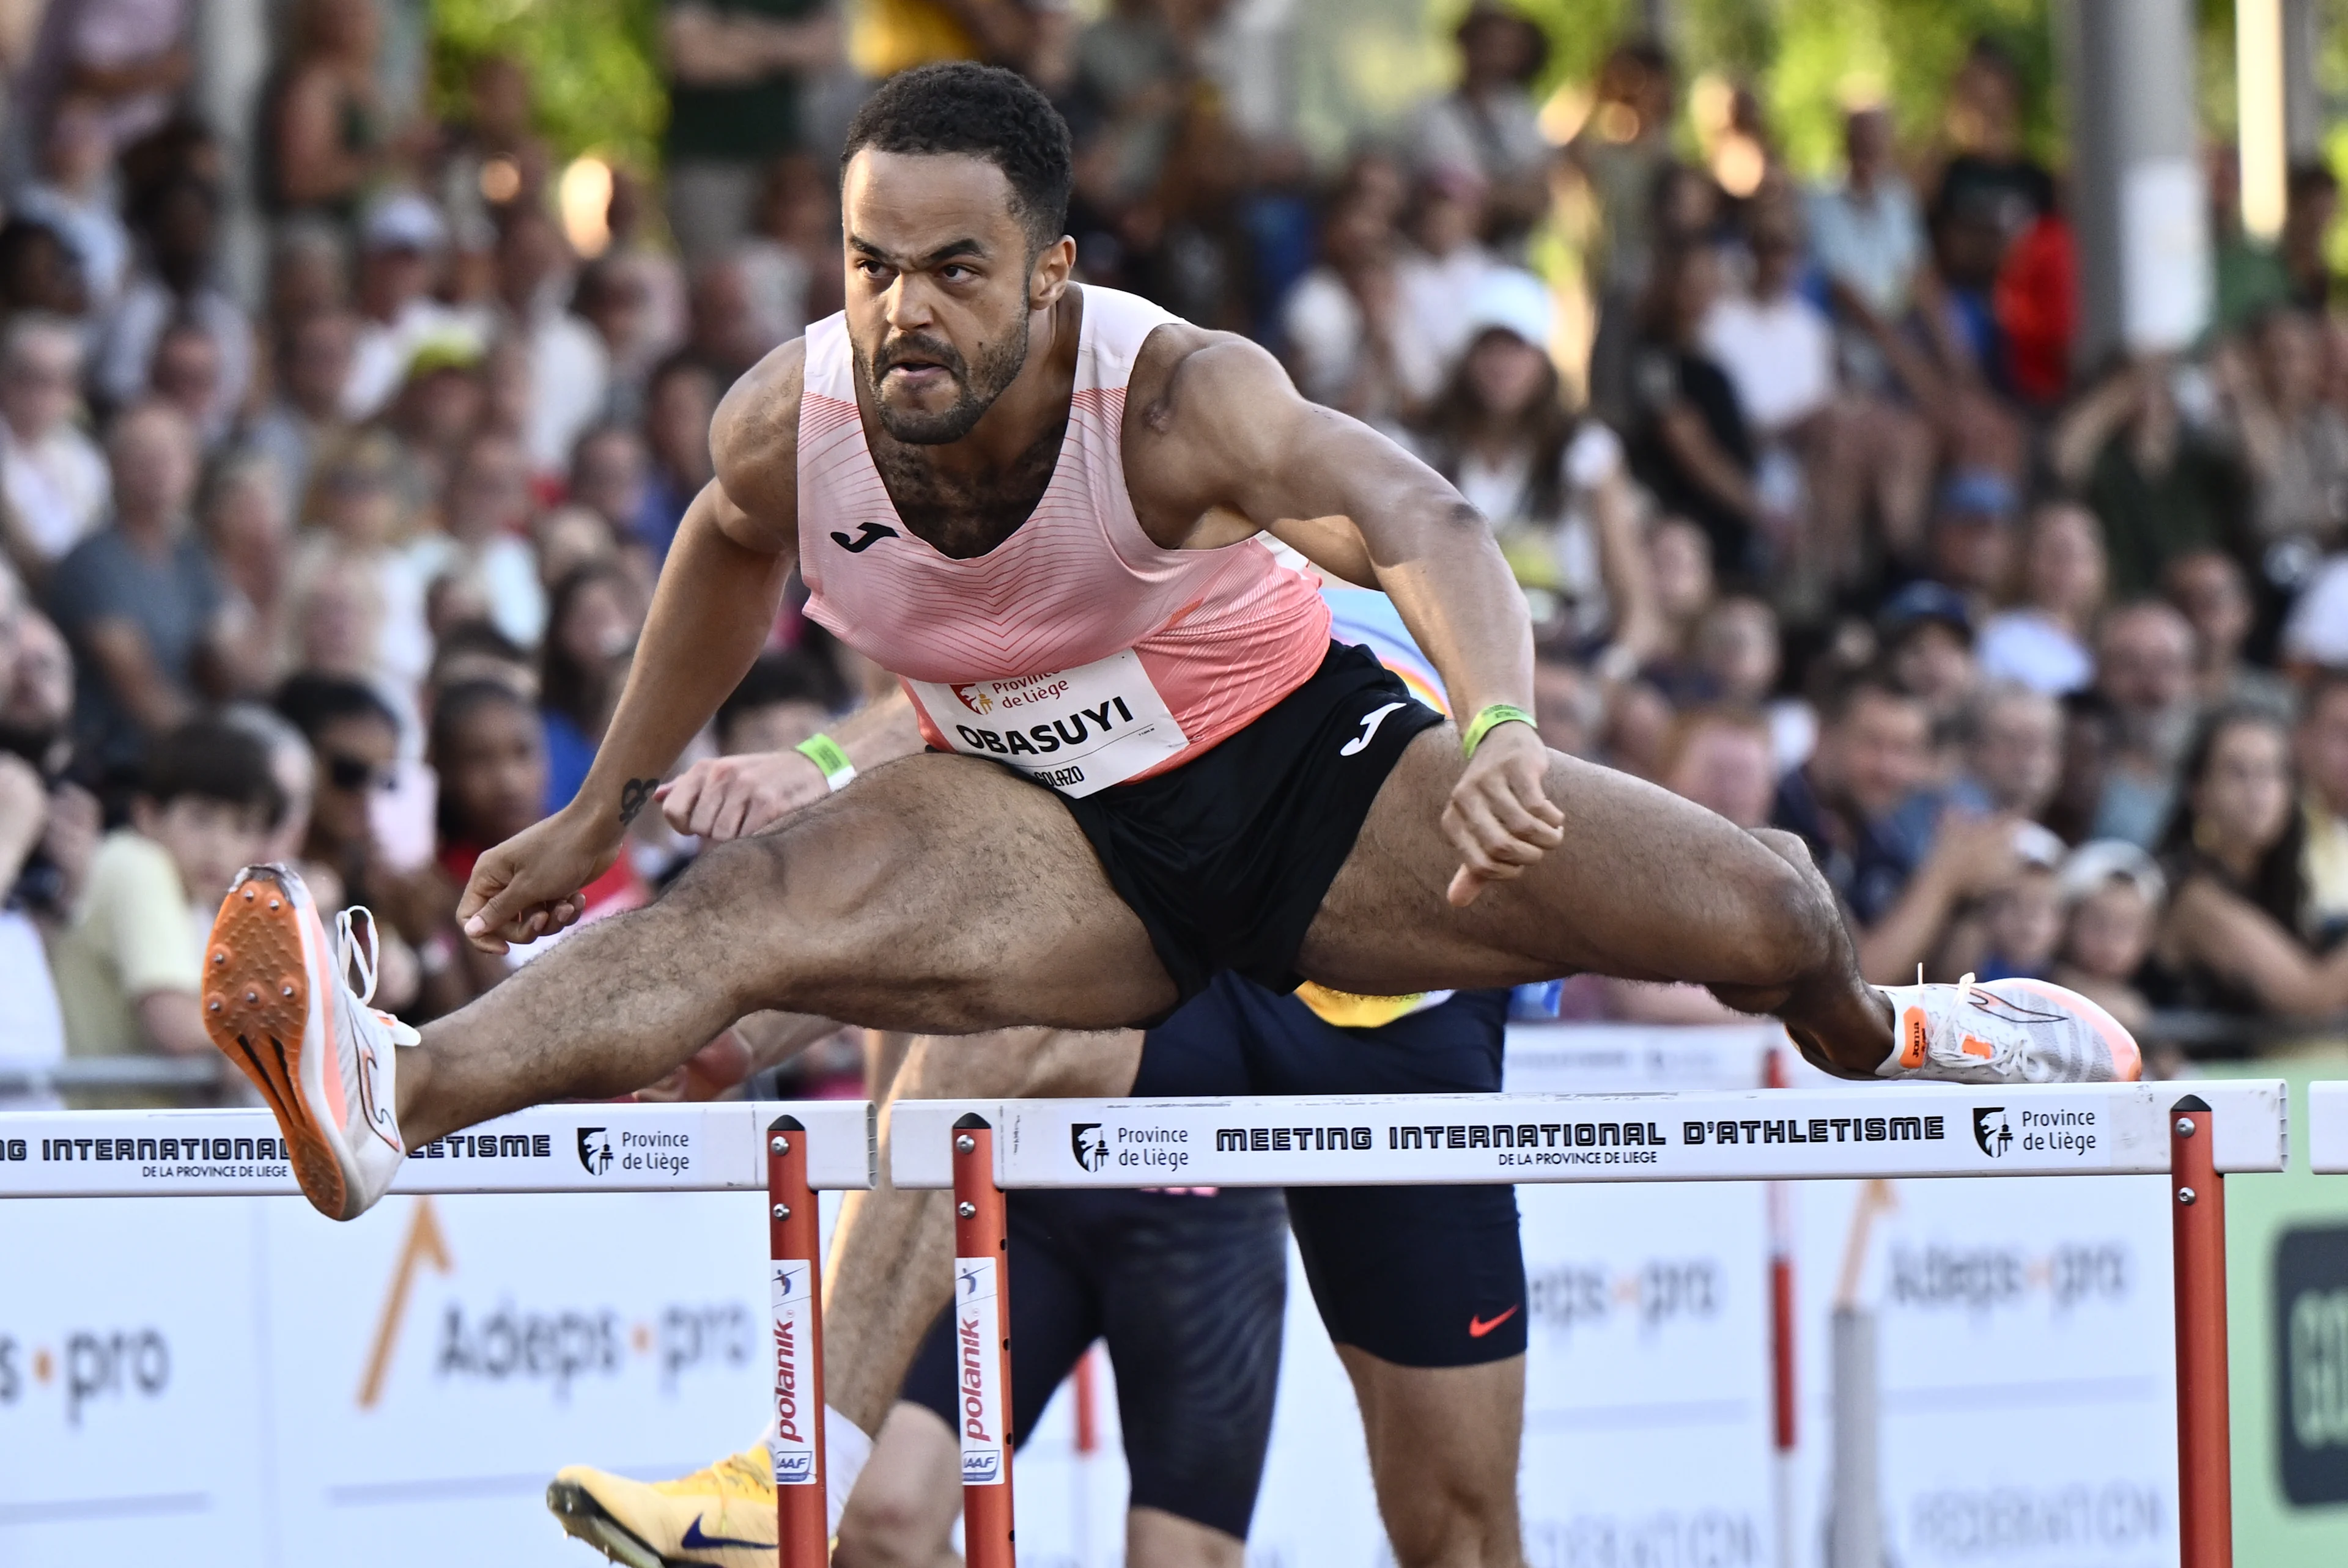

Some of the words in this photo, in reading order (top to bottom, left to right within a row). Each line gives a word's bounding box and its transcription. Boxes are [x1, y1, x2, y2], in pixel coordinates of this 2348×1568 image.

[992, 671, 1061, 694] Provinc
[1003, 696, 1024, 709] de
[1023, 680, 1069, 703] Liège
[956, 696, 1134, 755] OBASUYI
[2022, 1108, 2096, 1127] Province
[622, 1131, 690, 1147] Province
[1118, 1126, 1189, 1143] Province
[1216, 1127, 1372, 1152] MEETING
[1389, 1122, 1667, 1149] INTERNATIONAL
[2022, 1133, 2045, 1150] de
[622, 1154, 643, 1170] de
[1118, 1149, 1139, 1166] de
[1498, 1154, 1515, 1166] DE
[1517, 1153, 1534, 1165] LA
[1536, 1152, 1602, 1165] PROVINCE
[1604, 1152, 1620, 1165] DE
[1623, 1150, 1658, 1163] LIEGE
[142, 1166, 157, 1177] DE
[160, 1166, 174, 1177] LA
[176, 1165, 237, 1177] PROVINCE
[238, 1166, 254, 1177] DE
[256, 1165, 288, 1177] LIEGE
[773, 1318, 805, 1443] polanik
[959, 1317, 992, 1443] polanik
